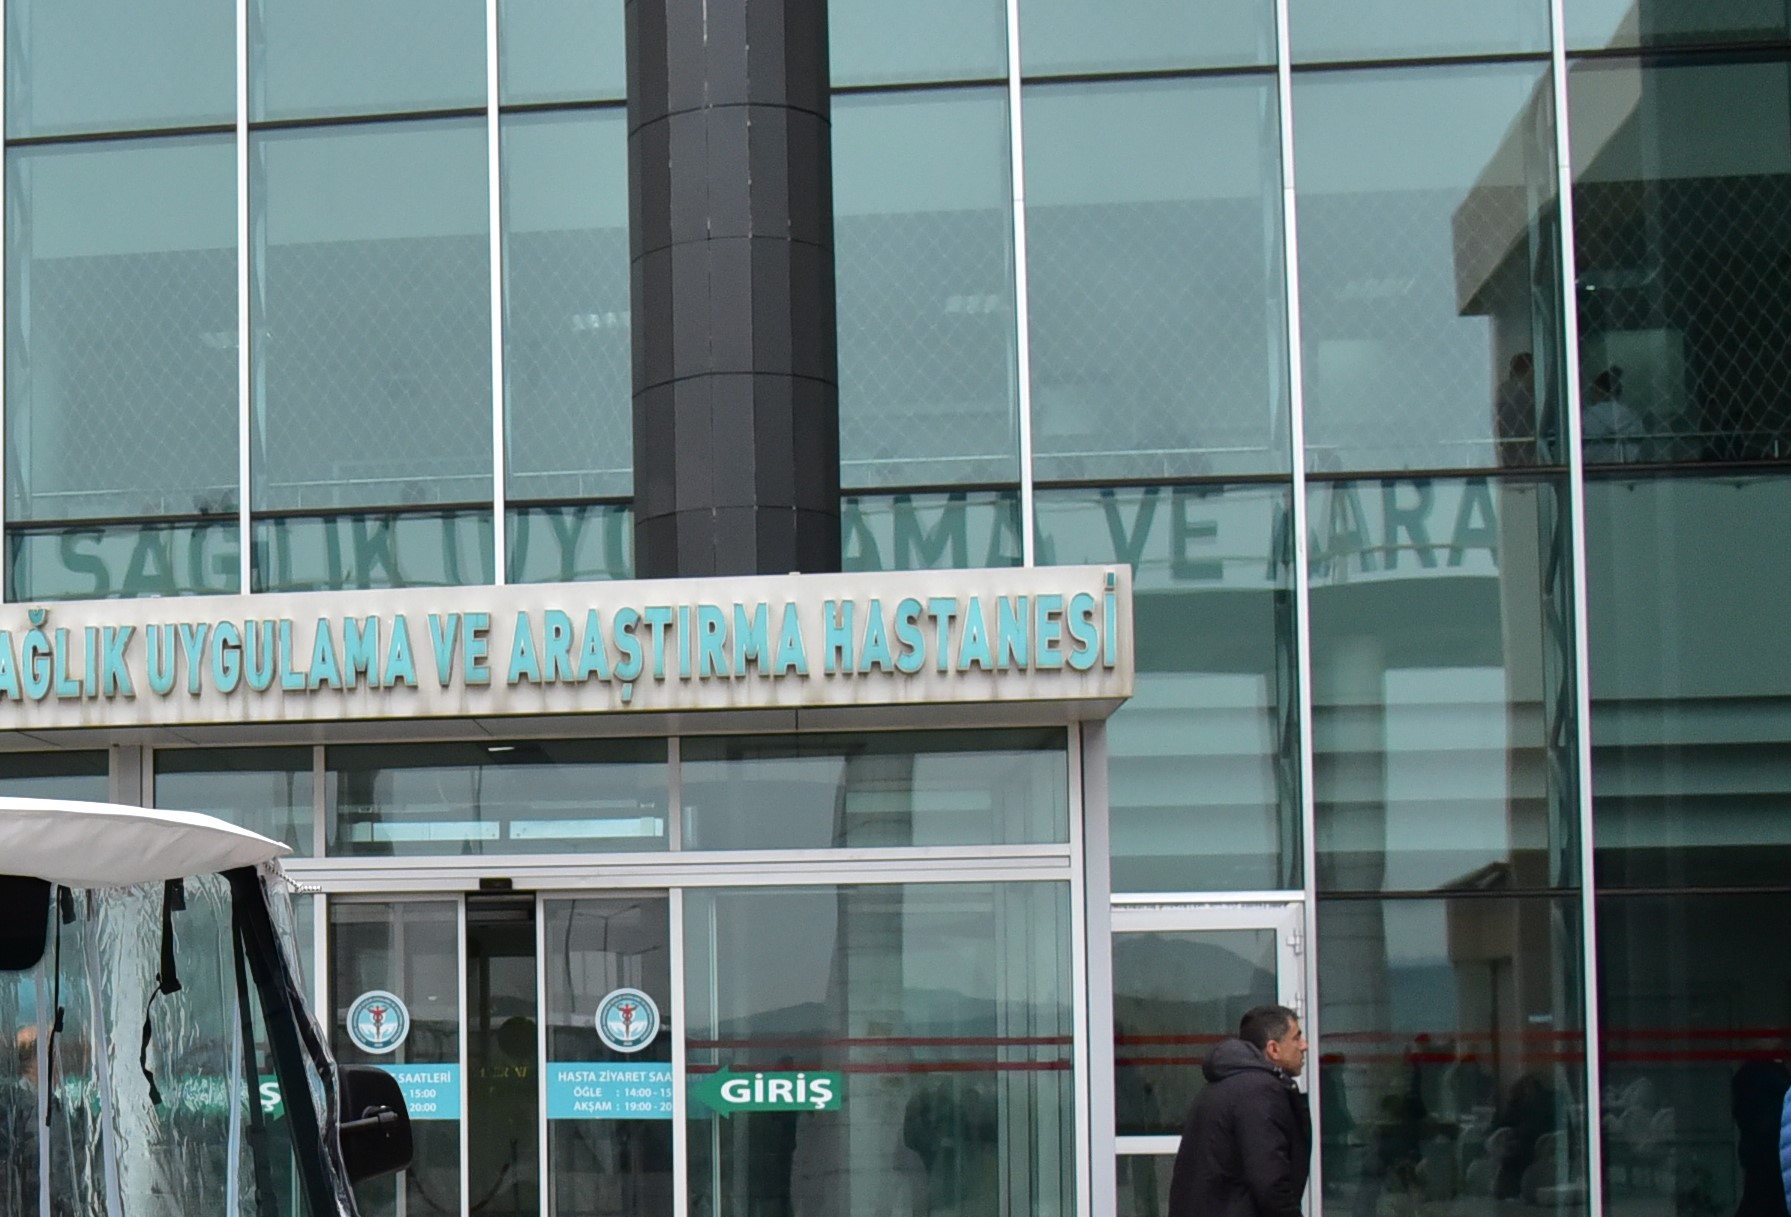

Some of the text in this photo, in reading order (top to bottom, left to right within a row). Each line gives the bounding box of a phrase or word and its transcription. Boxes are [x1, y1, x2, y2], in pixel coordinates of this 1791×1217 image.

[145, 613, 419, 697] UYGULAMA
[427, 611, 492, 688] VE
[507, 600, 809, 702] ARAŞTIRMA
[823, 571, 1117, 674] HASTANESİ
[398, 1070, 451, 1083] SAATLERİ
[558, 1070, 673, 1082] HASTA ZİYARET SAA
[409, 1089, 437, 1098] 15:00
[573, 1086, 602, 1098] ÖĞLE
[624, 1088, 652, 1098] 14:00
[720, 1072, 833, 1110] GİRİŞ
[409, 1103, 437, 1112] 20:00
[573, 1101, 612, 1114] AKŞAM
[624, 1102, 652, 1112] 19:00
